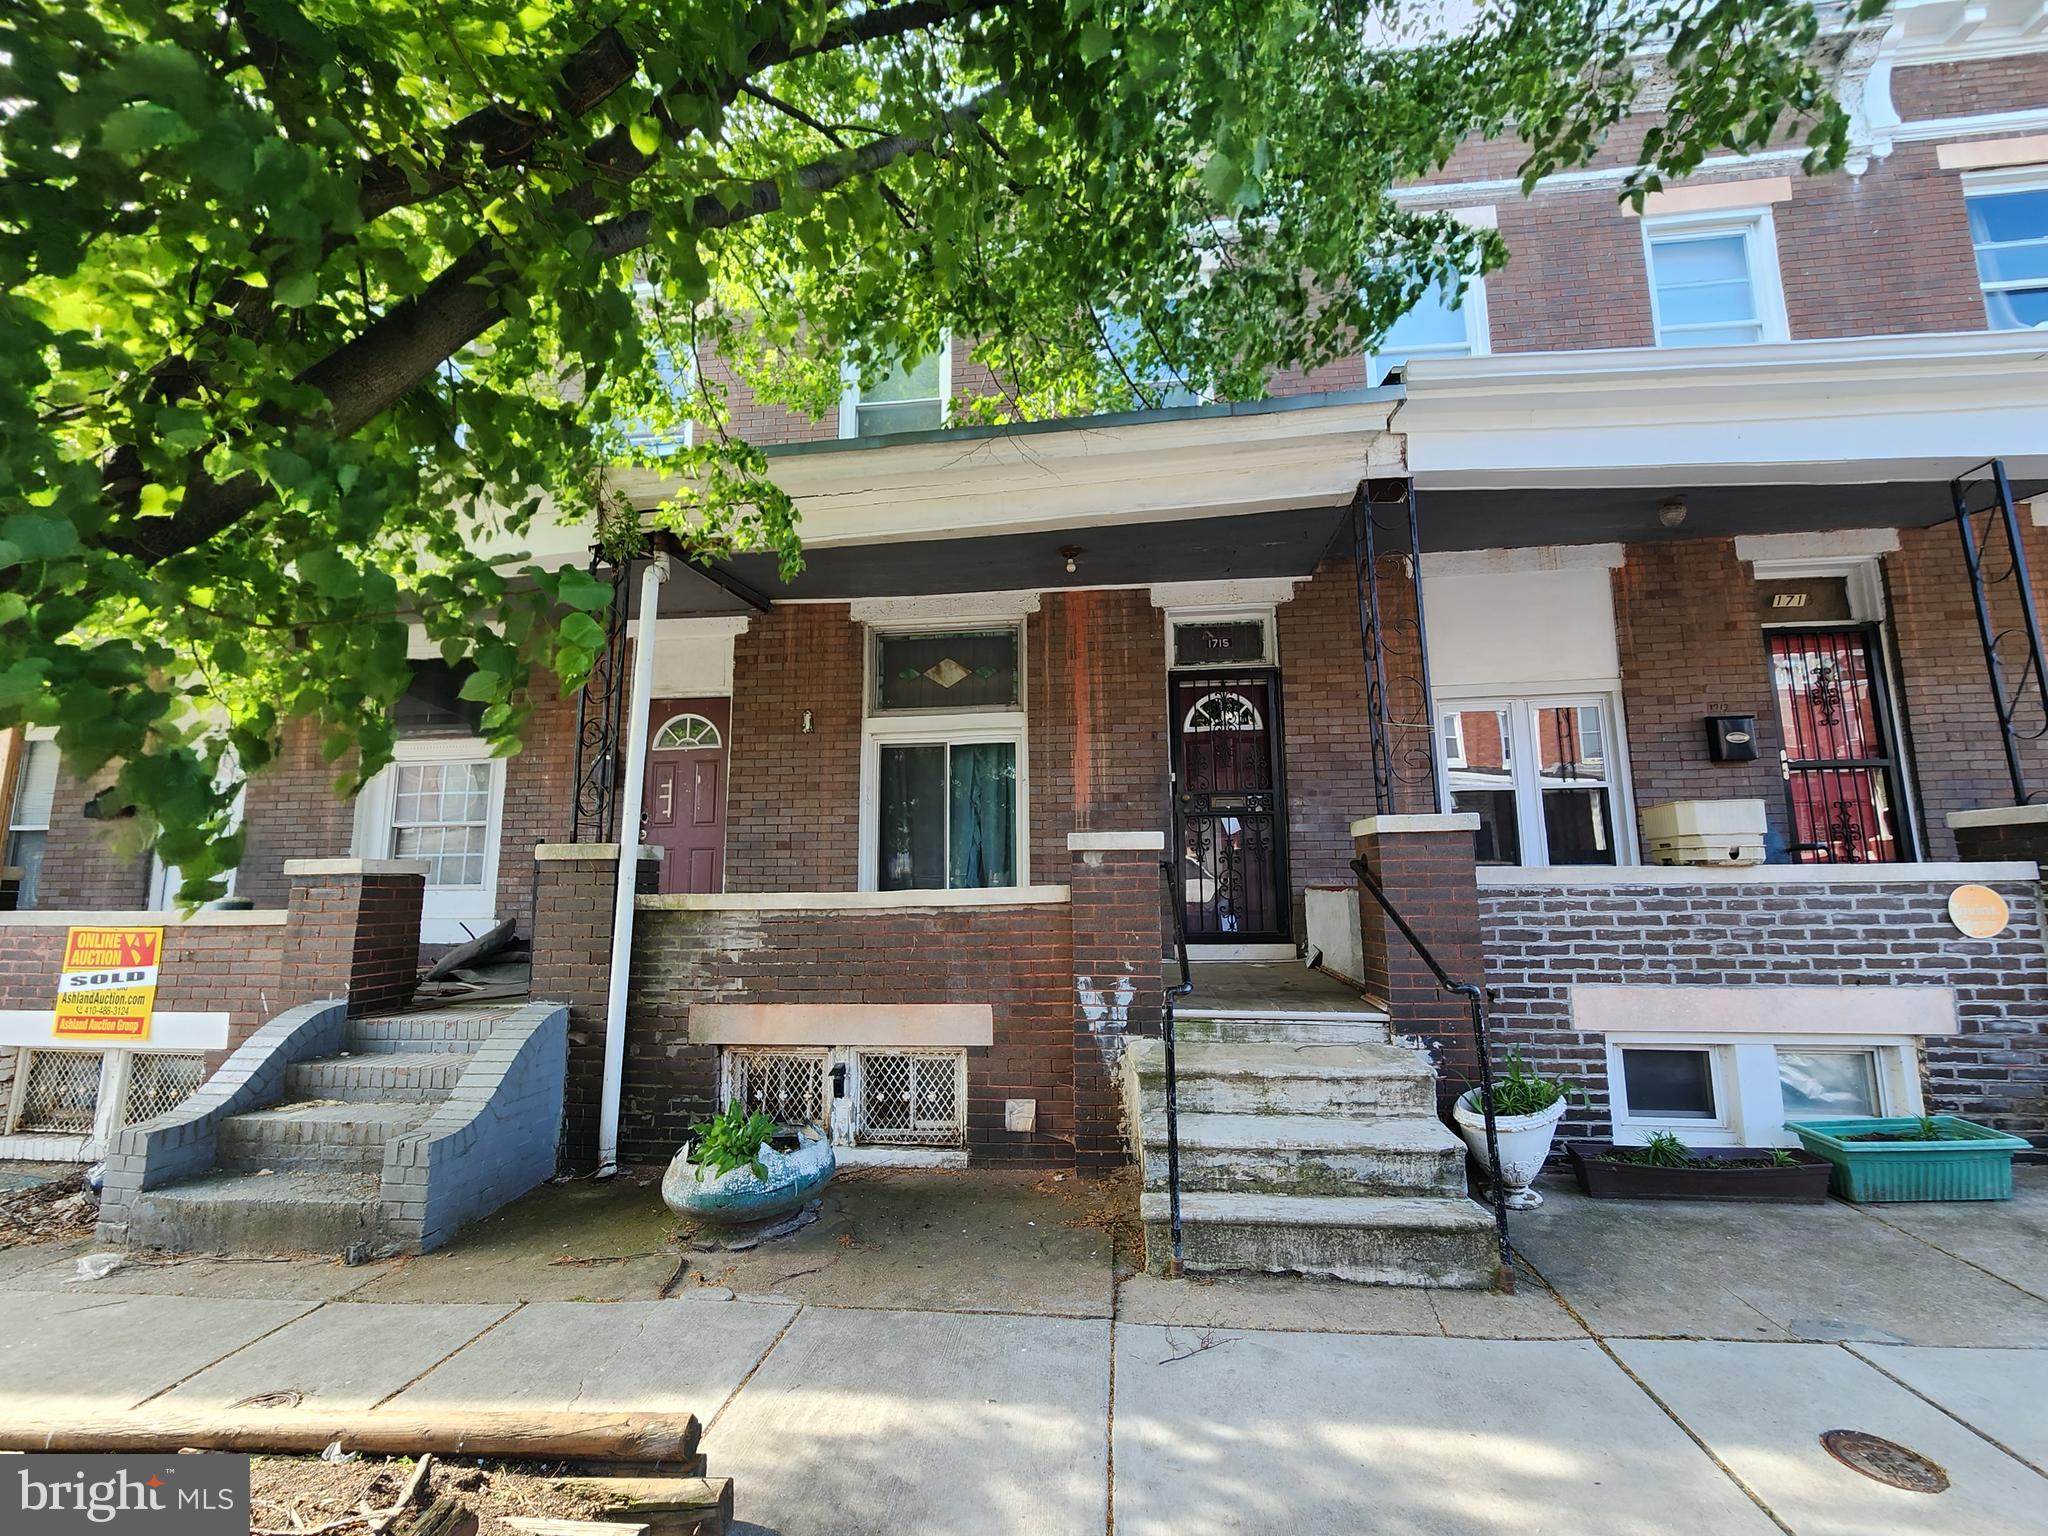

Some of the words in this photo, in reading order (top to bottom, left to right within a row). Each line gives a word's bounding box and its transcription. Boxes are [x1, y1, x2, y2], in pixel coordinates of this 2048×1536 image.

[1208, 638, 1230, 648] 1715
[77, 932, 122, 949] ONLINE
[70, 949, 122, 966] AUCTION
[70, 971, 145, 986] SOLD
[61, 992, 145, 1005] AshlandAuction.com
[58, 1018, 89, 1030] Ashland
[87, 1019, 117, 1031] Auction
[116, 1020, 139, 1034] Group
